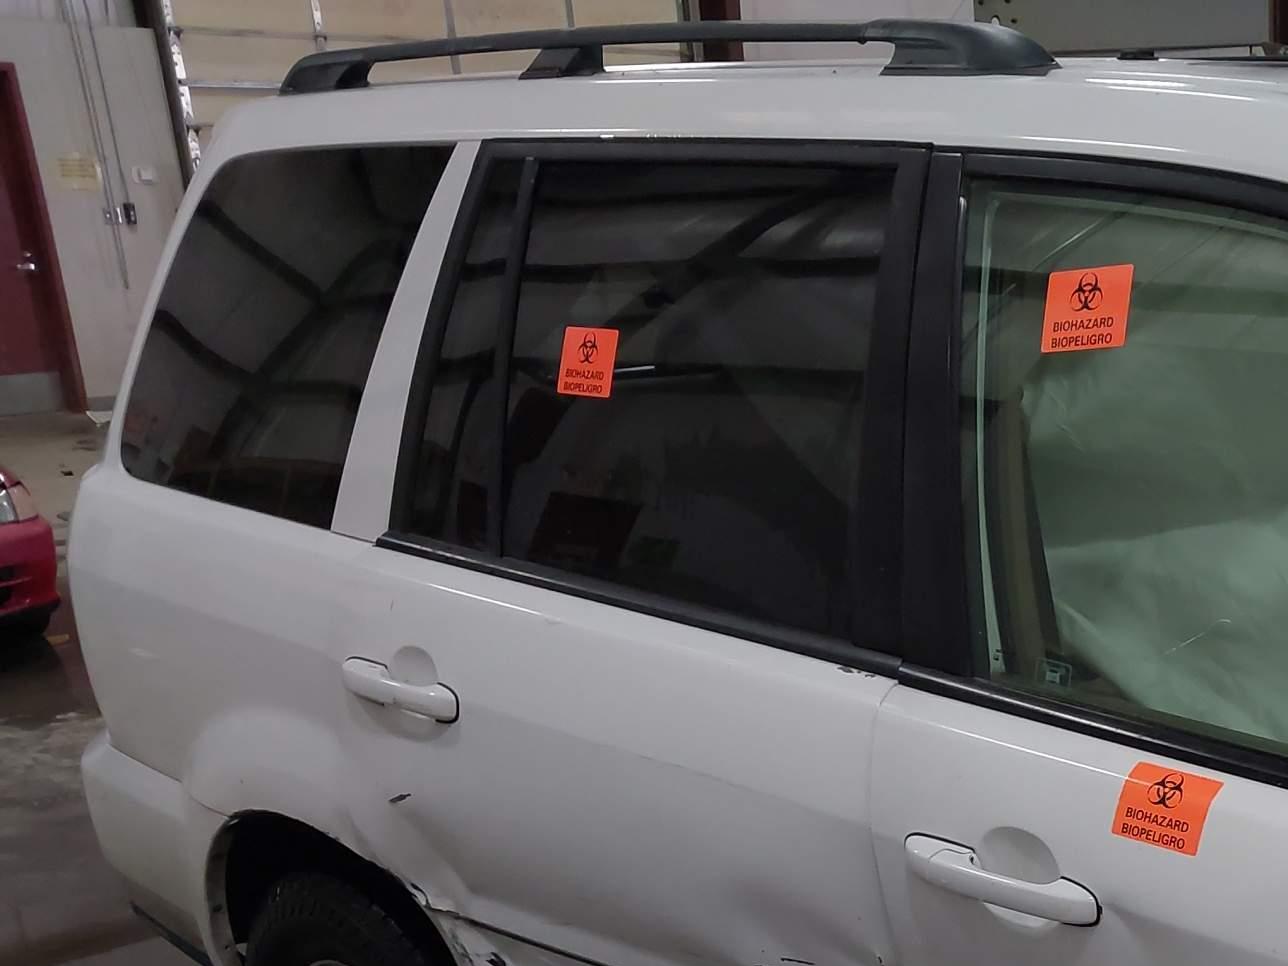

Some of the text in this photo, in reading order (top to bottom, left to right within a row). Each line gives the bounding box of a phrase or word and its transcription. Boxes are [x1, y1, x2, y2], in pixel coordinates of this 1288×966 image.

[1053, 316, 1114, 333] BIOHAZARD
[1051, 333, 1113, 349] BIOPELIGRO
[565, 368, 604, 380] BIOHAZARD
[563, 381, 603, 394] BIOPELIGRO
[1125, 806, 1189, 833] BIOHAZARD
[1121, 822, 1185, 850] BIOPELIGRO
